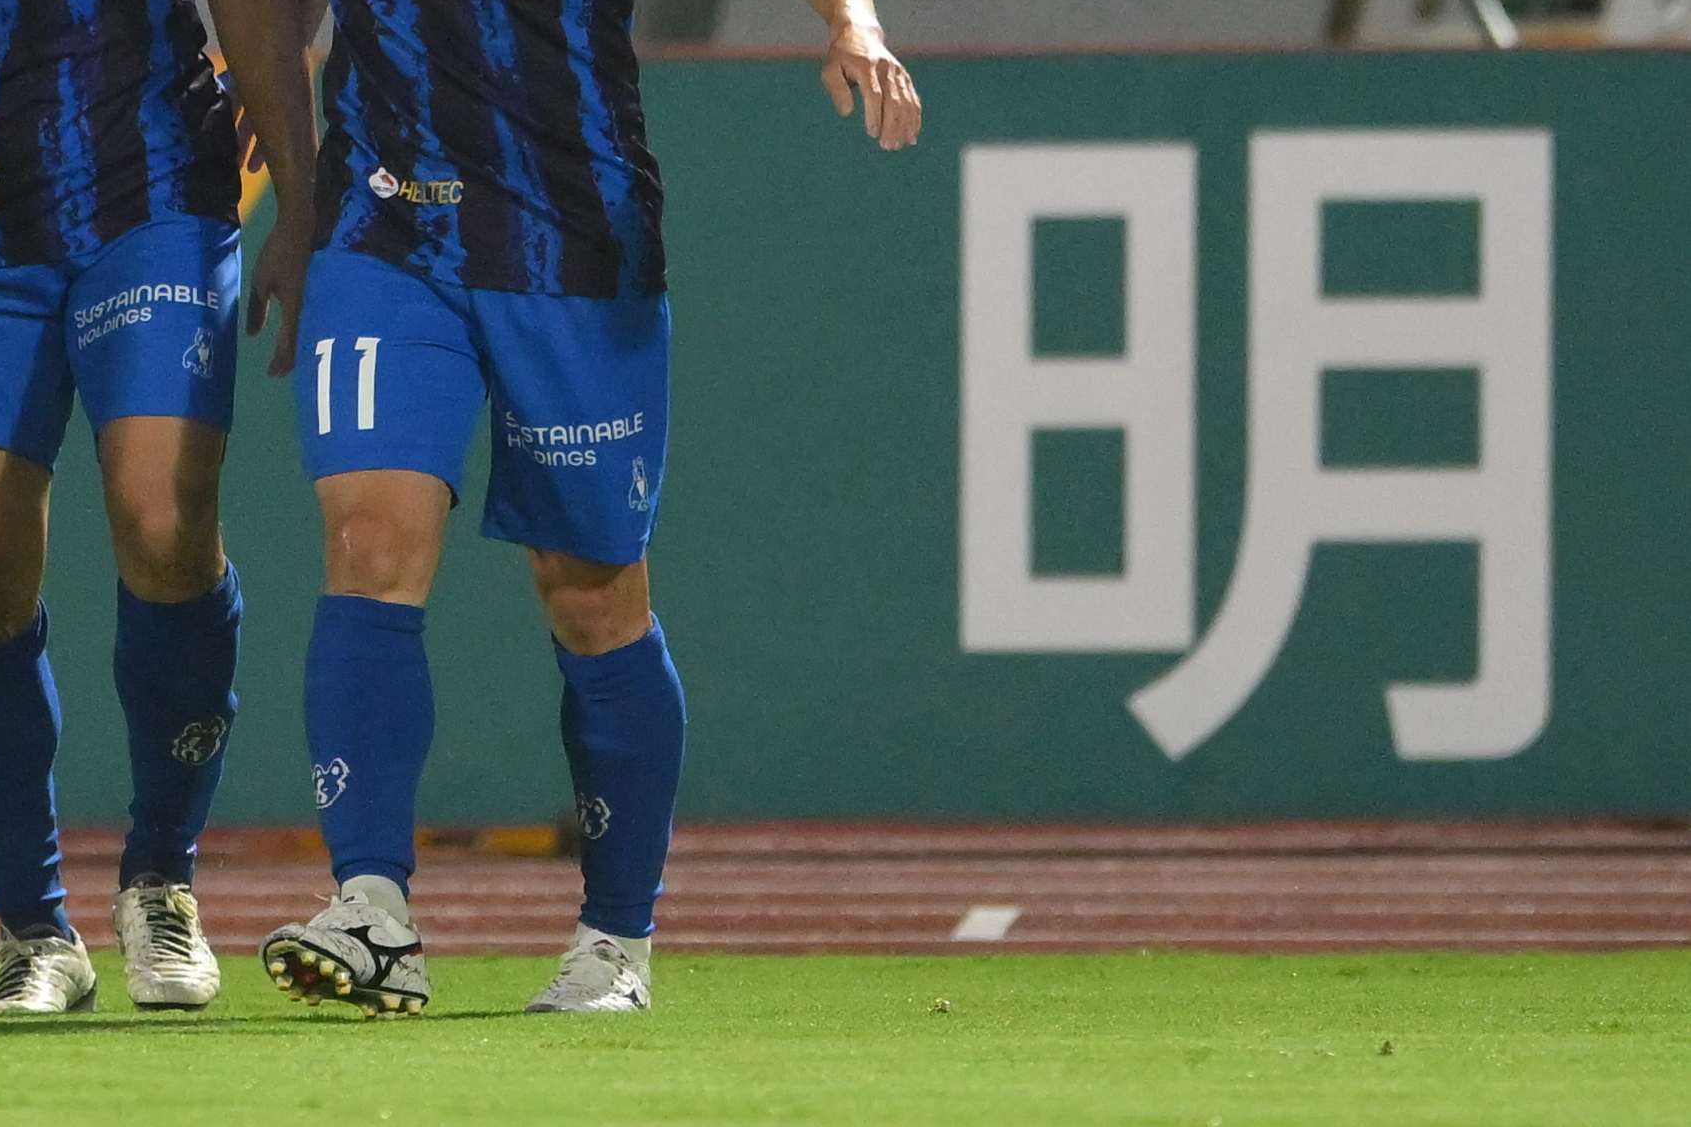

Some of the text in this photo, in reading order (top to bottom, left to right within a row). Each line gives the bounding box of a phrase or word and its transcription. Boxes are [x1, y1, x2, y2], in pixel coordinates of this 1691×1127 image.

[398, 180, 464, 204] HELTEC
[74, 284, 219, 329] SUSTAINABLE
[78, 307, 152, 350] HOLDINGS
[315, 337, 381, 435] 11
[506, 412, 643, 446] SSTAINABLE
[960, 127, 1553, 762] 明
